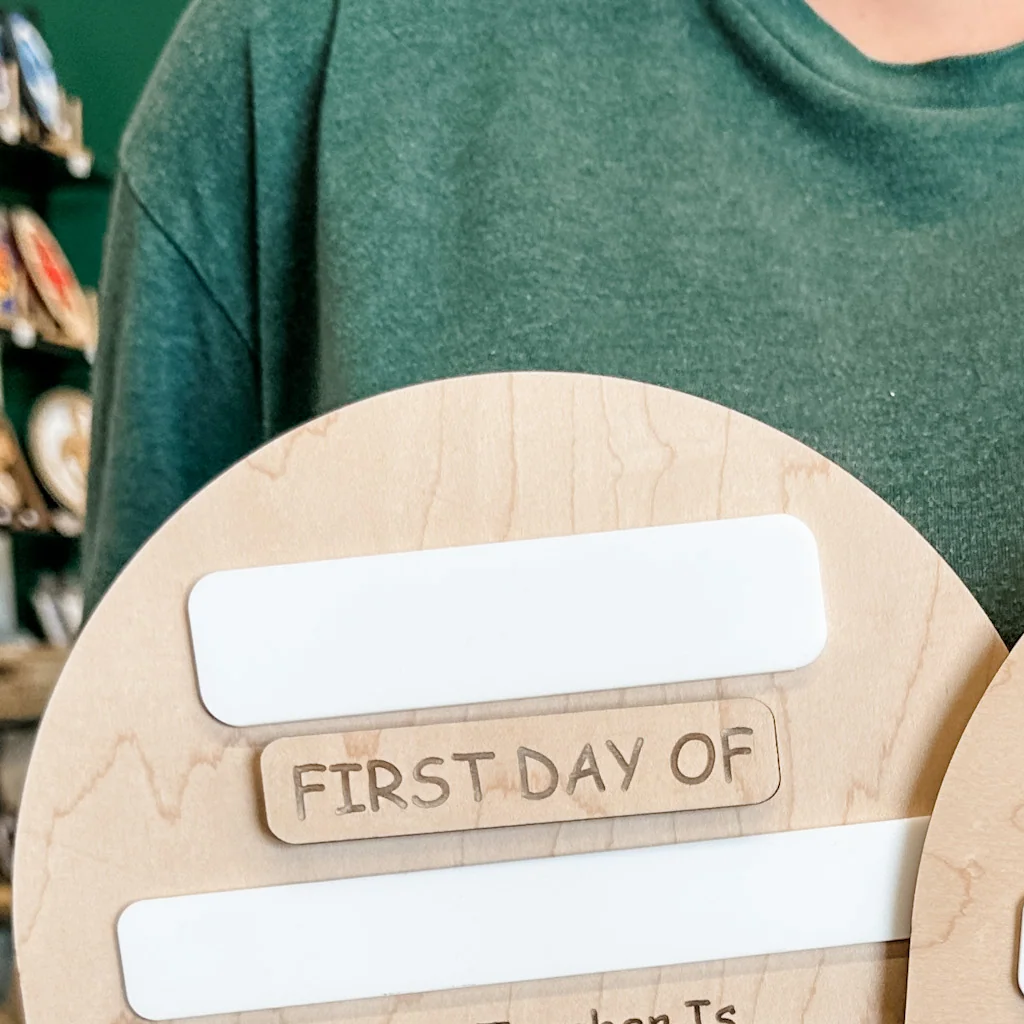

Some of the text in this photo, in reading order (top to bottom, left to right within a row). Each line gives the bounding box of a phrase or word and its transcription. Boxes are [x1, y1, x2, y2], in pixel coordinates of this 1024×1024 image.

[292, 726, 754, 820] FIRST DAY OF
